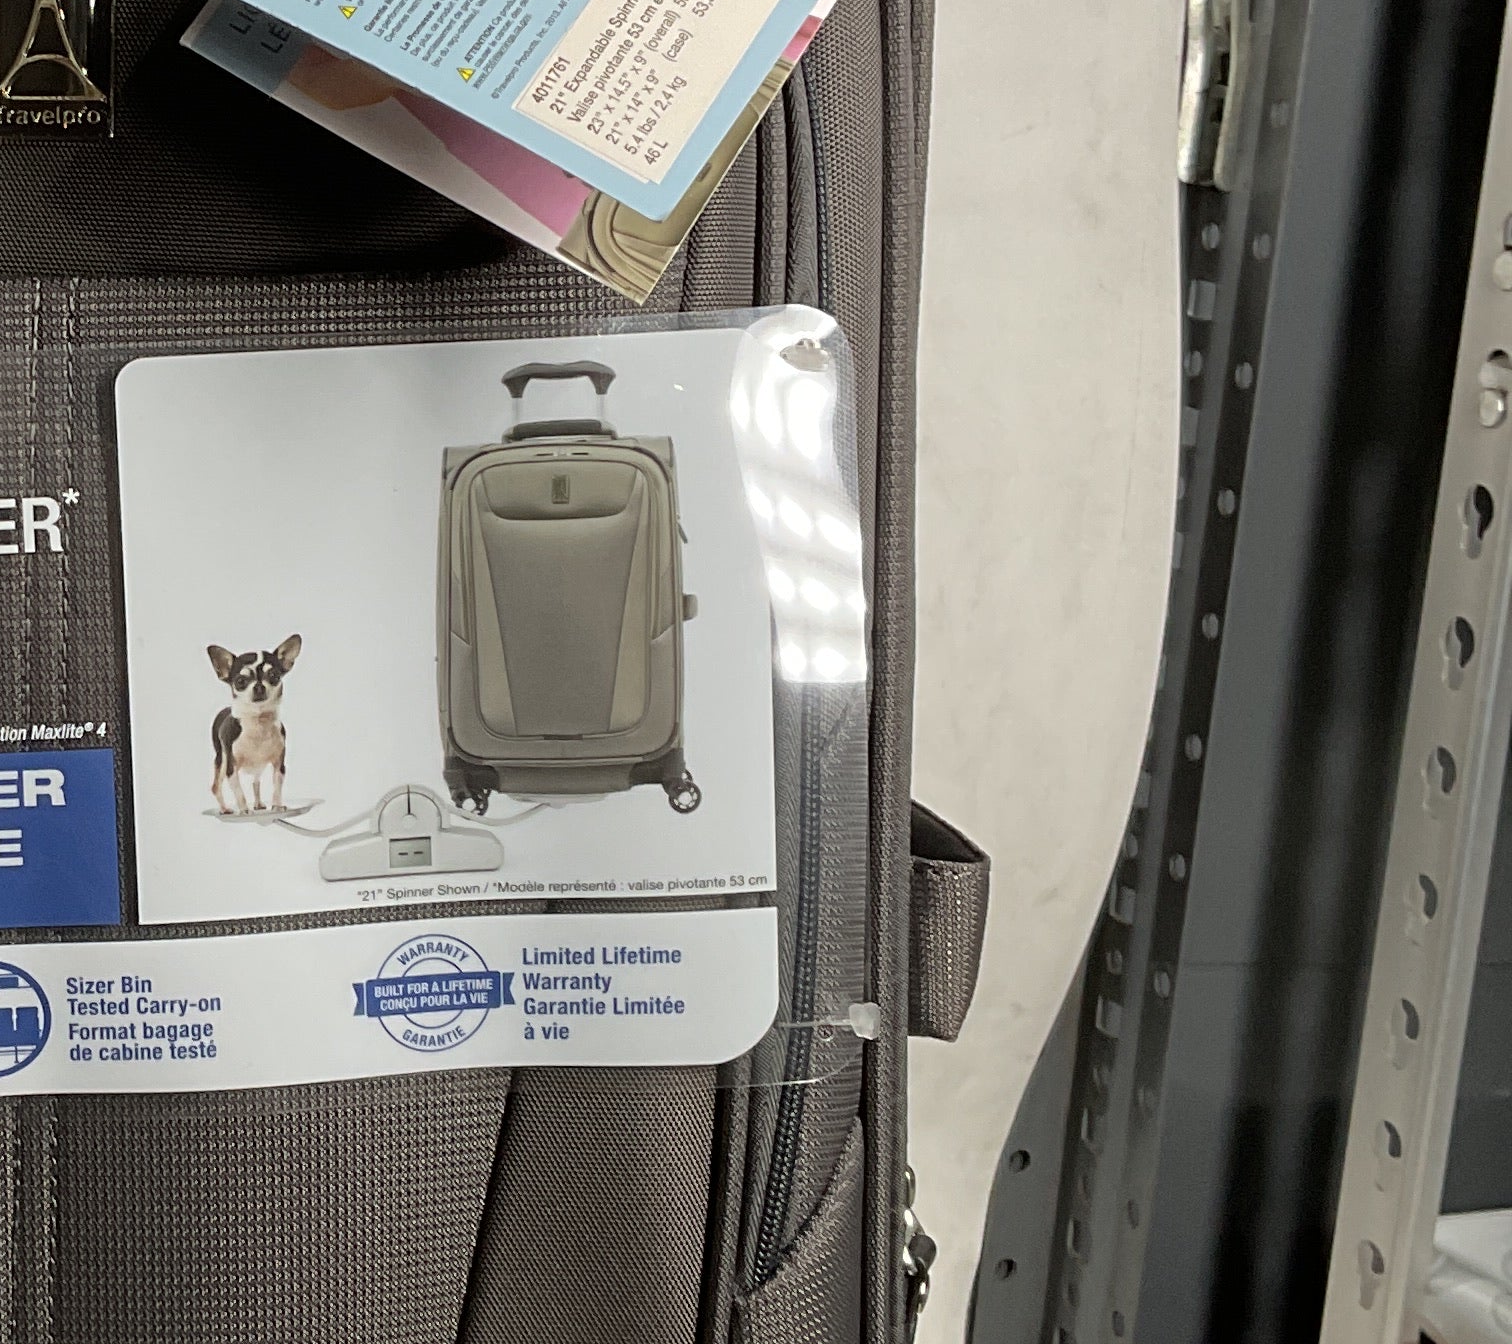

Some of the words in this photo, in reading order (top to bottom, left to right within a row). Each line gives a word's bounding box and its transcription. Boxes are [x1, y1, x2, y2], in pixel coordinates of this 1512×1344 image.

[643, 10, 680, 51] (overall)
[662, 29, 692, 61] (case)
[564, 29, 615, 92] Expandable
[567, 91, 597, 121] Valise
[594, 40, 633, 91] pivotante
[627, 23, 643, 38] 53
[641, 6, 656, 22] cm
[532, 57, 569, 102] 4011761
[624, 135, 643, 154] 5.4
[637, 118, 656, 135] lbs
[655, 91, 673, 110] 2,4
[666, 76, 686, 91] kg
[645, 148, 660, 164] 46
[387, 887, 434, 901] Spinner
[438, 884, 481, 896] Shown
[548, 879, 617, 893] représenté
[628, 878, 664, 891] valise
[668, 877, 726, 892] pivotante
[729, 875, 745, 886] 53
[748, 874, 768, 886] cm
[396, 941, 470, 967] WARRANTY
[522, 946, 596, 966] Limited
[602, 945, 683, 965] Lifetime
[65, 976, 116, 995] Sizer
[121, 975, 152, 994] Bin
[374, 984, 405, 1000] BUILT
[406, 982, 431, 997] FOR
[441, 977, 494, 993] LIFETIME
[523, 971, 612, 994] Warranty
[67, 997, 130, 1016] Tested
[136, 996, 222, 1018] Carry-on
[380, 996, 420, 1013] CONÇU
[420, 994, 450, 1008] POUR
[452, 993, 468, 1005] LA
[469, 991, 489, 1005] VIE
[523, 996, 606, 1016] Garantie
[613, 994, 685, 1015] Limitée
[68, 1021, 136, 1041] Format
[143, 1021, 215, 1043] bagage
[402, 1025, 467, 1048] GARANTIE
[523, 1021, 536, 1040] à
[541, 1021, 570, 1040] vie
[69, 1044, 93, 1062] de
[98, 1042, 163, 1062] cabine
[169, 1038, 217, 1059] testé
